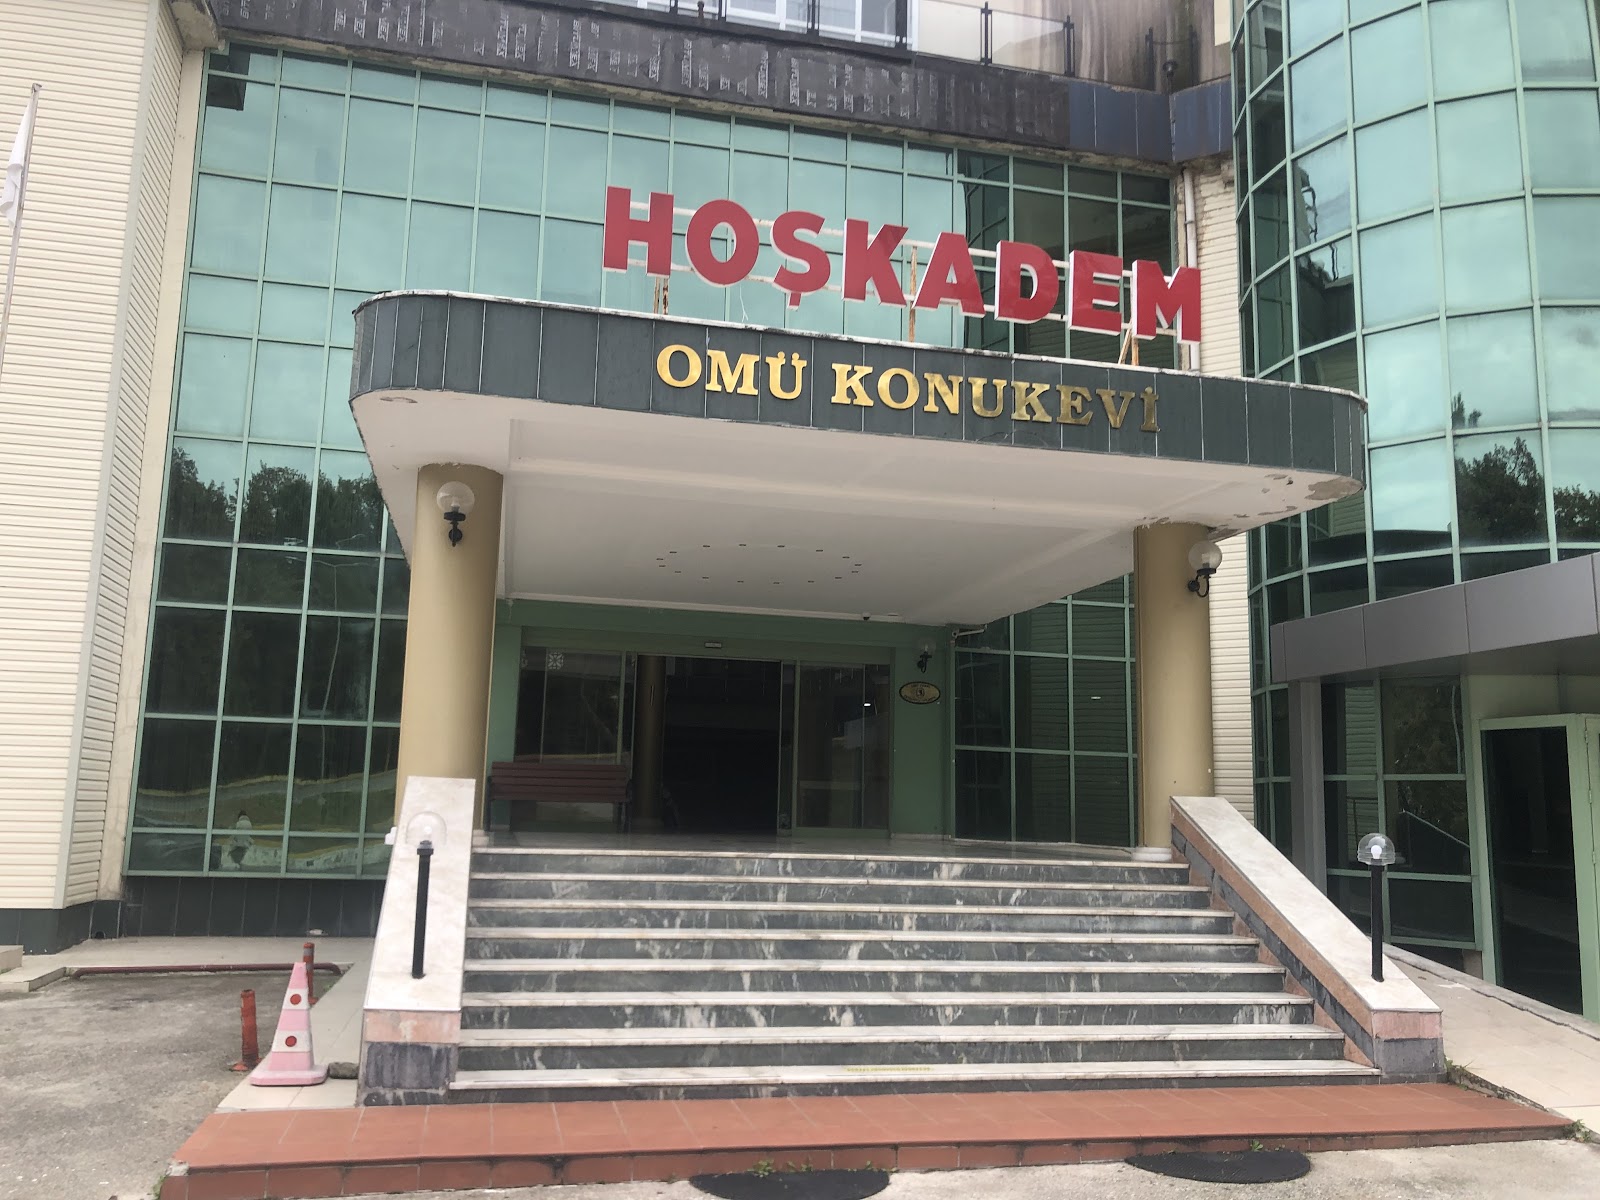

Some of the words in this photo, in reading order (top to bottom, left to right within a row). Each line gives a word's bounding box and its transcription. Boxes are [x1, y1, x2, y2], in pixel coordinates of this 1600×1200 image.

[603, 186, 1201, 344] HOŞKADEM
[656, 343, 808, 400] OMÜ
[831, 362, 1161, 432] KONUKEVİ
